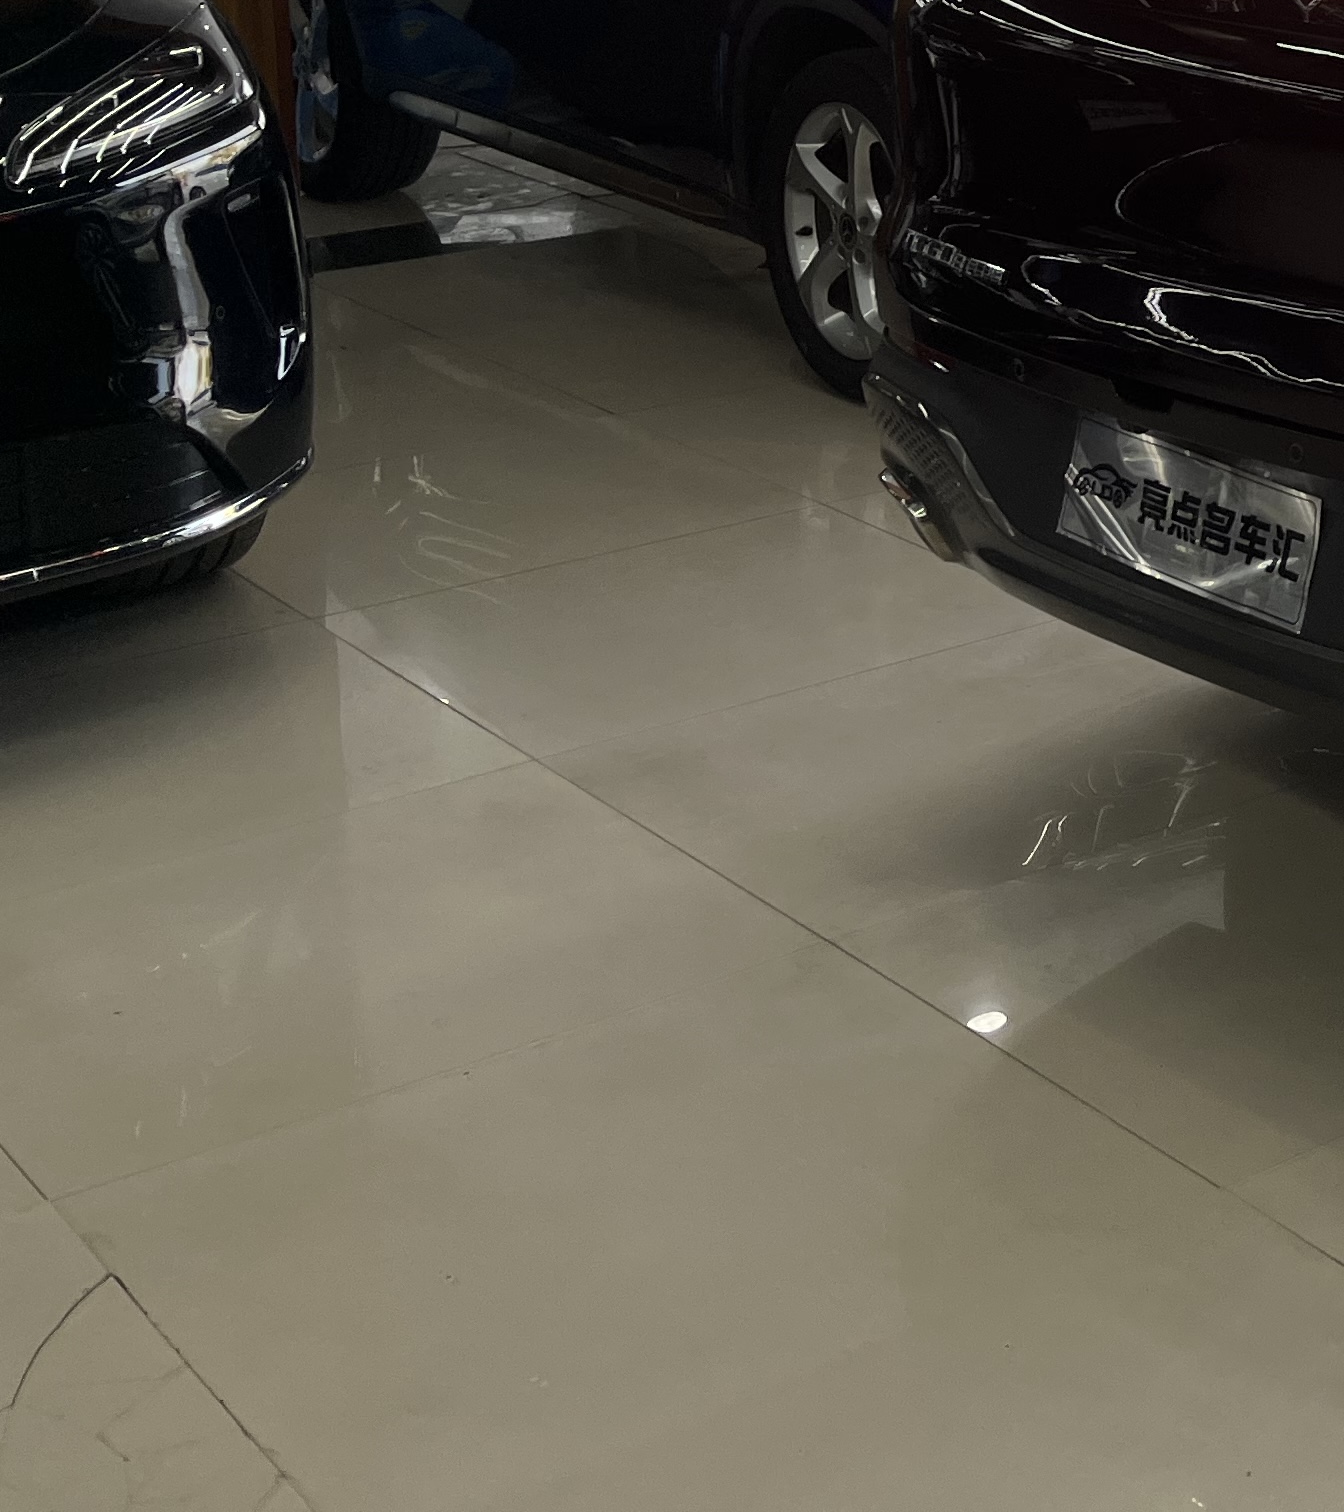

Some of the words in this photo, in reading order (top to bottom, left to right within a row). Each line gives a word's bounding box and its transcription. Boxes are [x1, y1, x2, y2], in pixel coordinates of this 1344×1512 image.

[1137, 478, 1306, 583] 亮点名车汇
